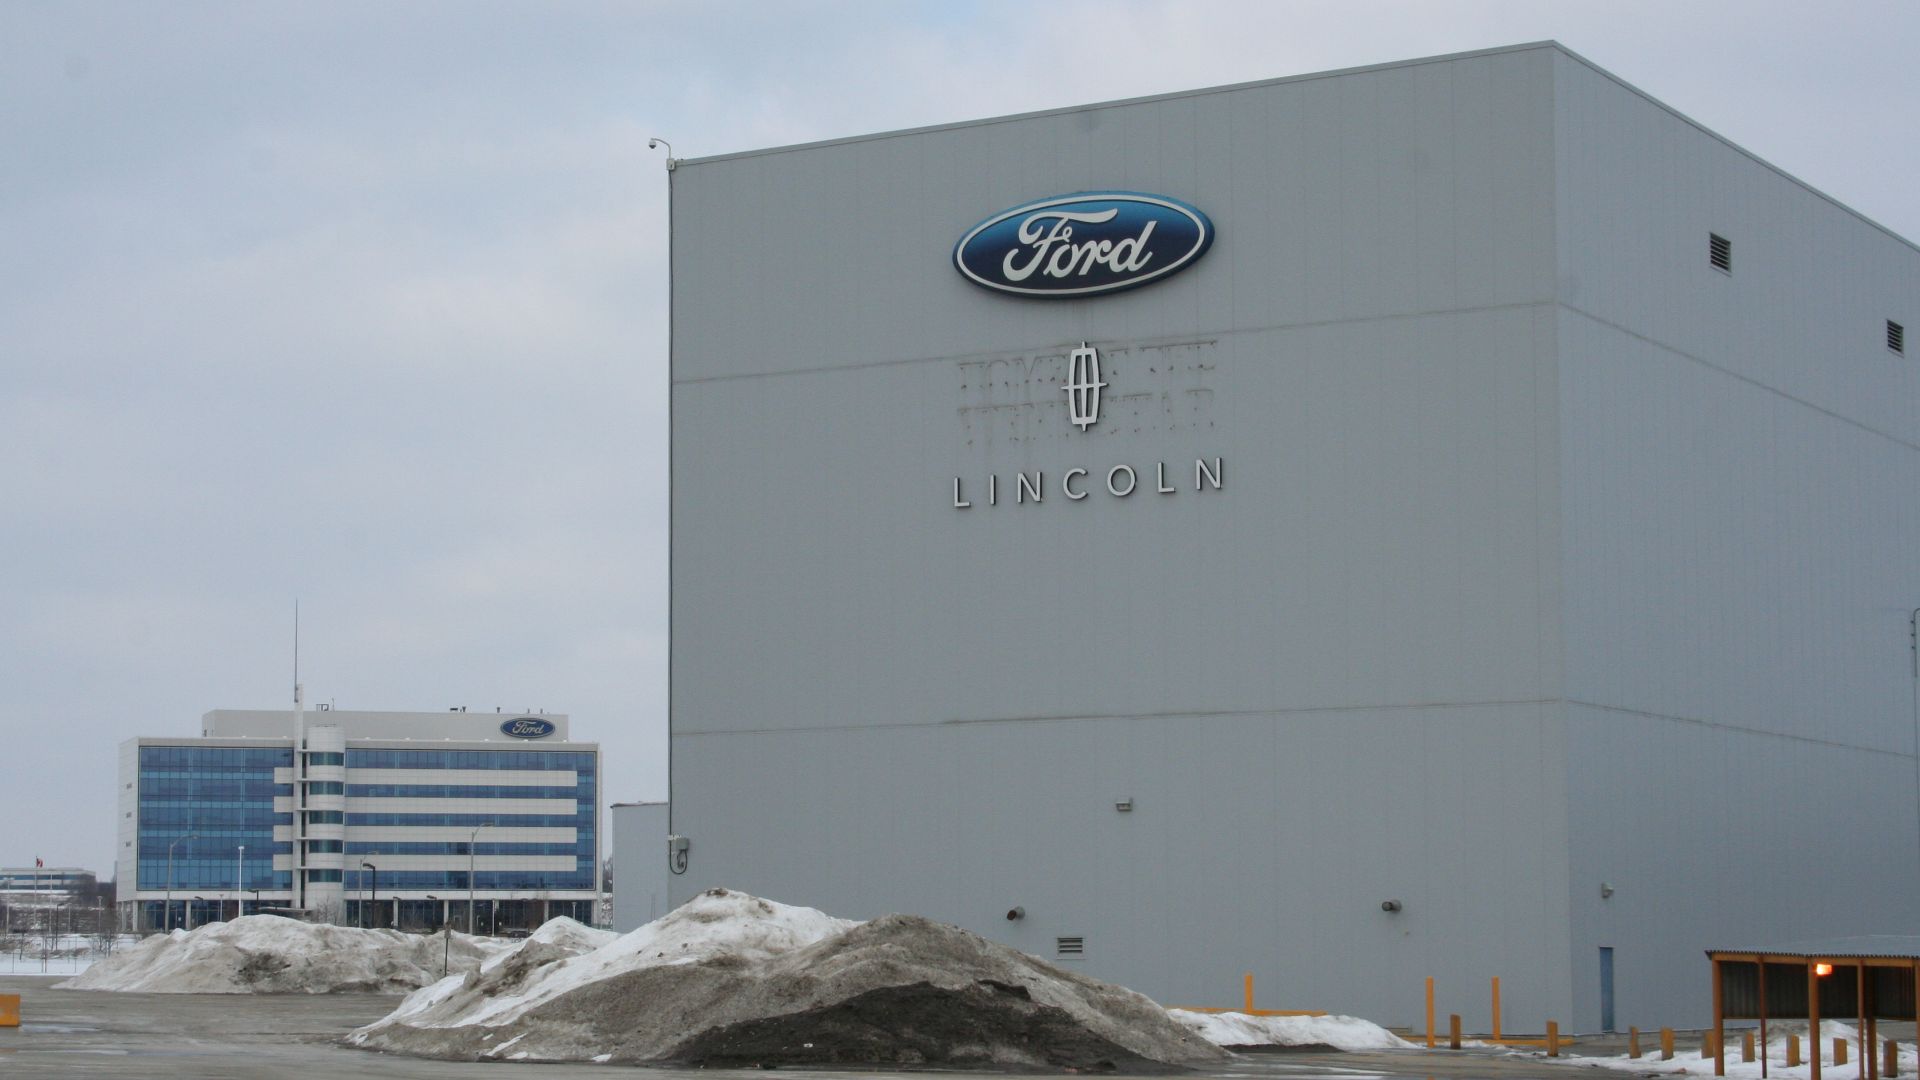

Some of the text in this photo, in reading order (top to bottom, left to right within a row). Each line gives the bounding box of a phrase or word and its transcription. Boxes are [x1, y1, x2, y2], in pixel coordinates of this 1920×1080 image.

[1003, 208, 1157, 281] Ford
[954, 457, 1222, 507] LINCOLN
[512, 720, 544, 733] Ford
